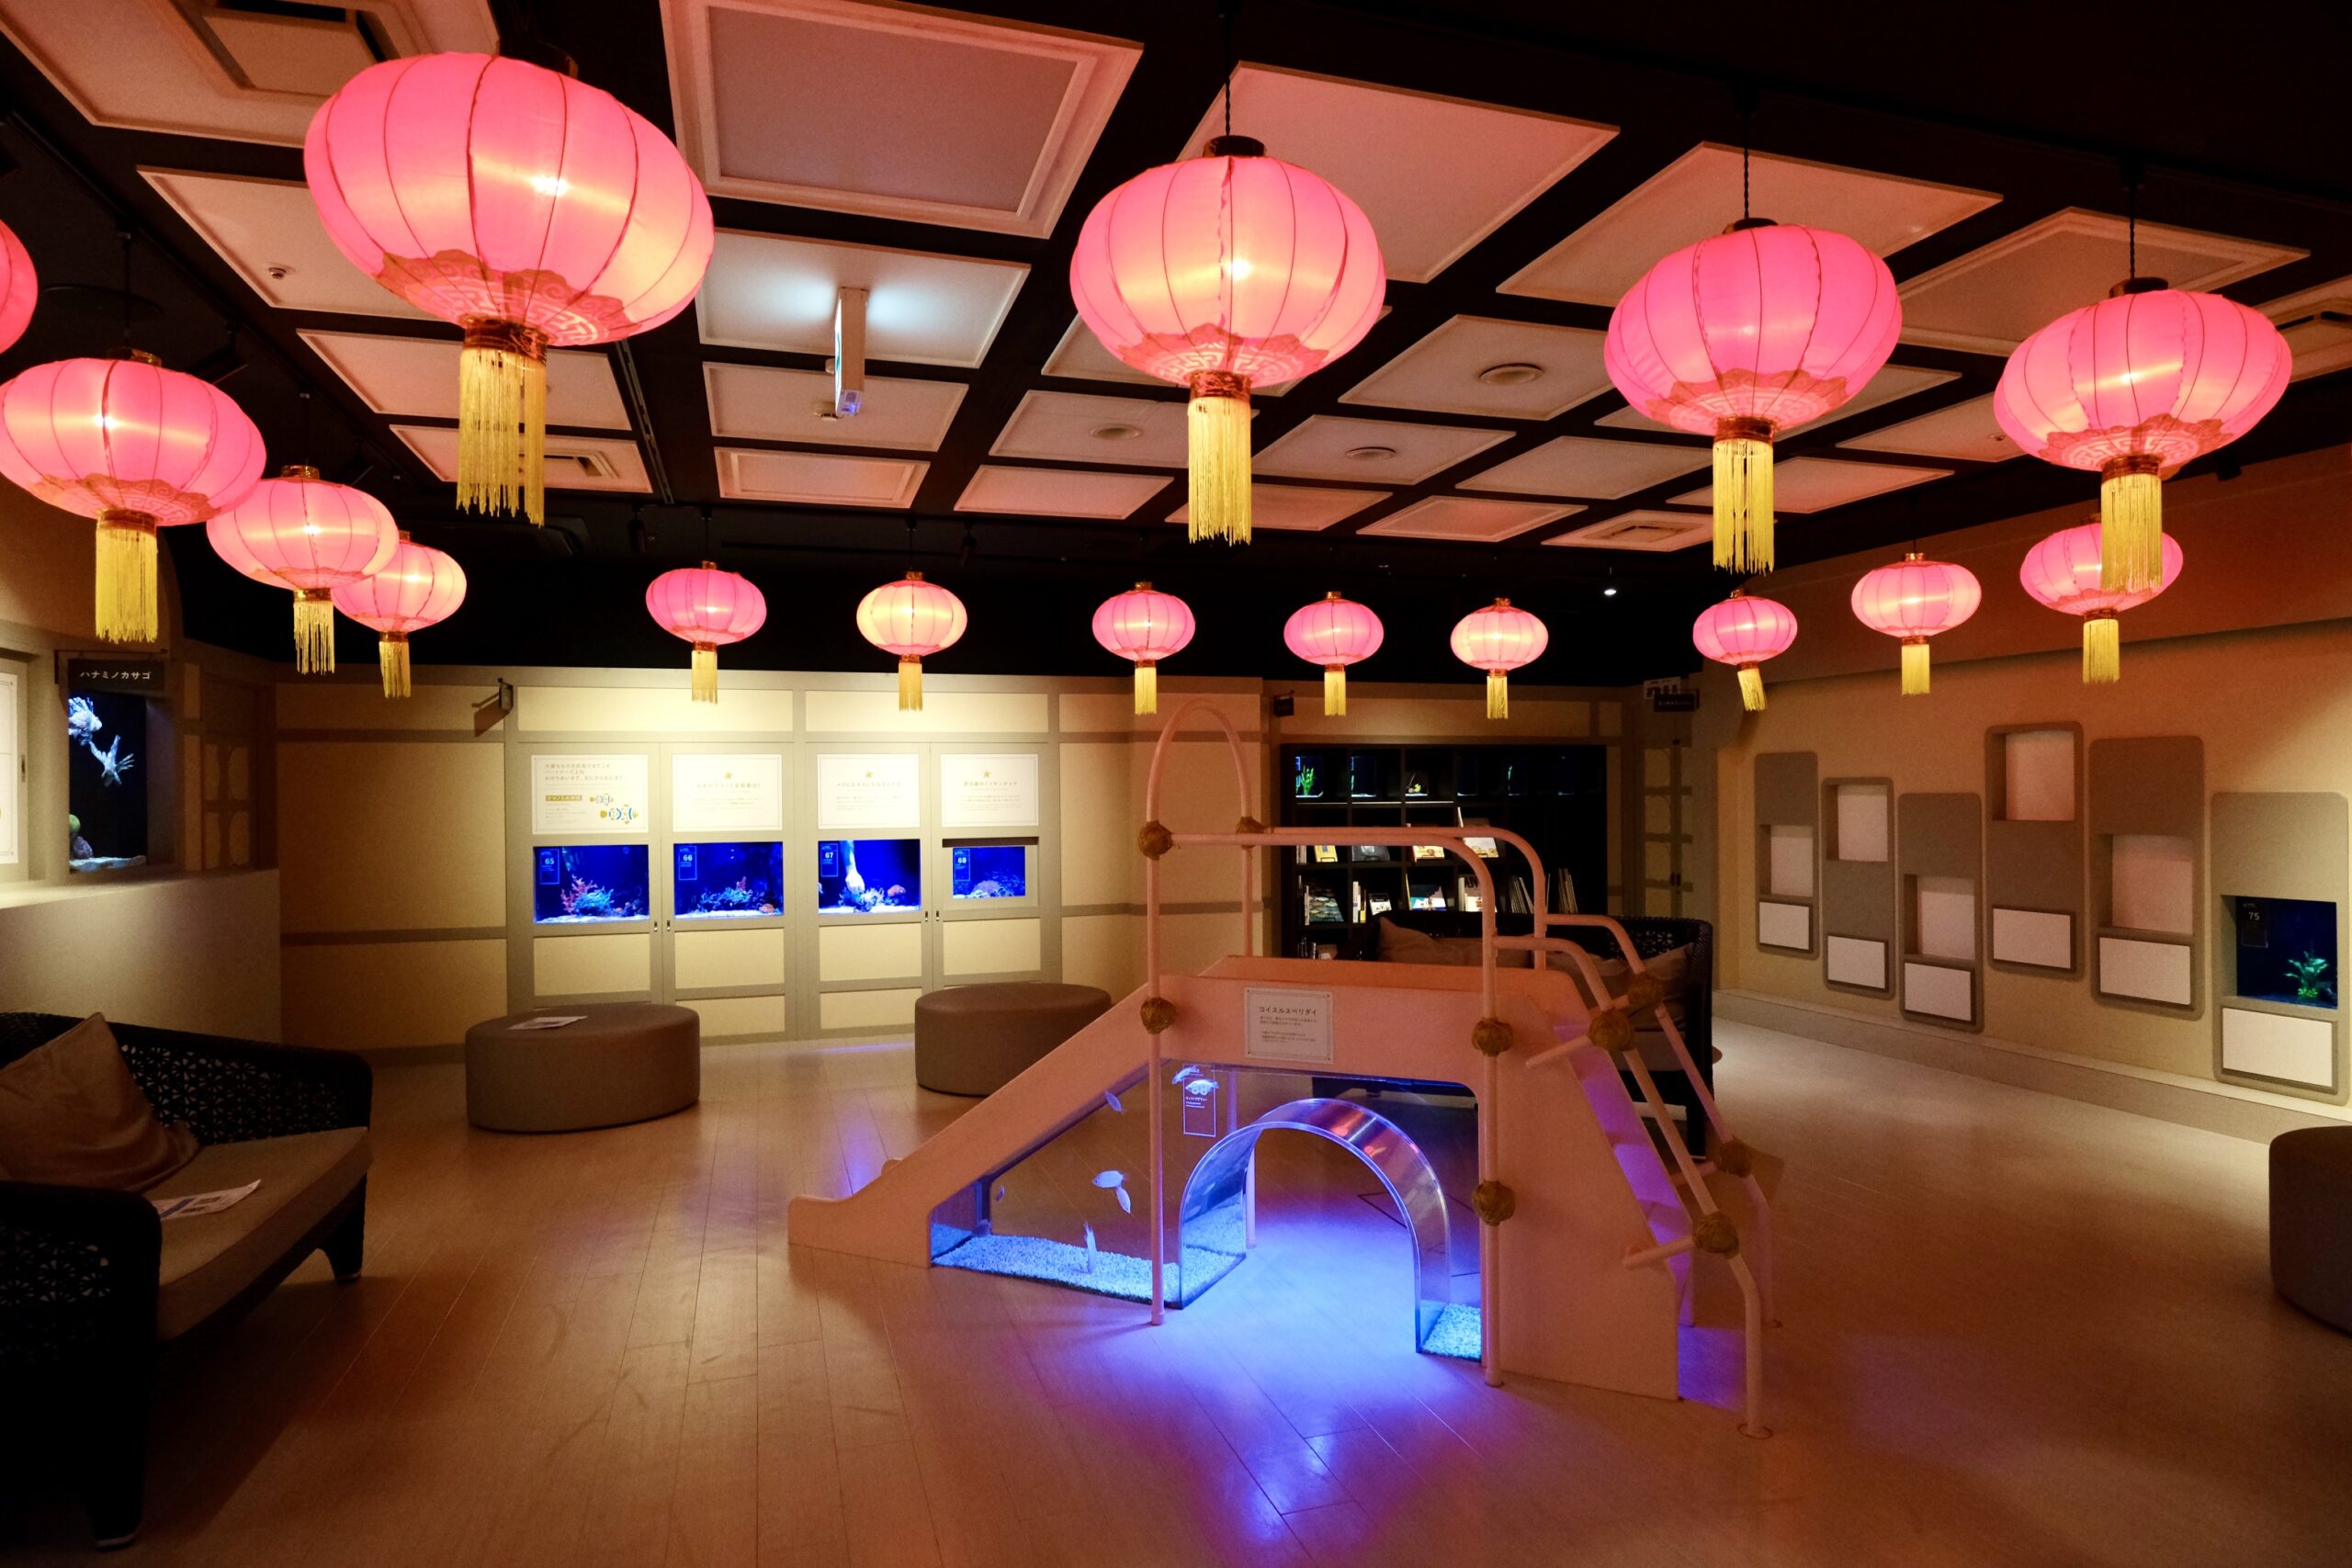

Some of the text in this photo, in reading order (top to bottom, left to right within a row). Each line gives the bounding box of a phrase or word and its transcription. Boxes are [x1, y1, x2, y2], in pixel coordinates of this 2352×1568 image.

[80, 671, 151, 681] ハナミノカサゴ
[2248, 911, 2260, 921] 75
[1260, 1006, 1317, 1016] コイスルスベリダイ
